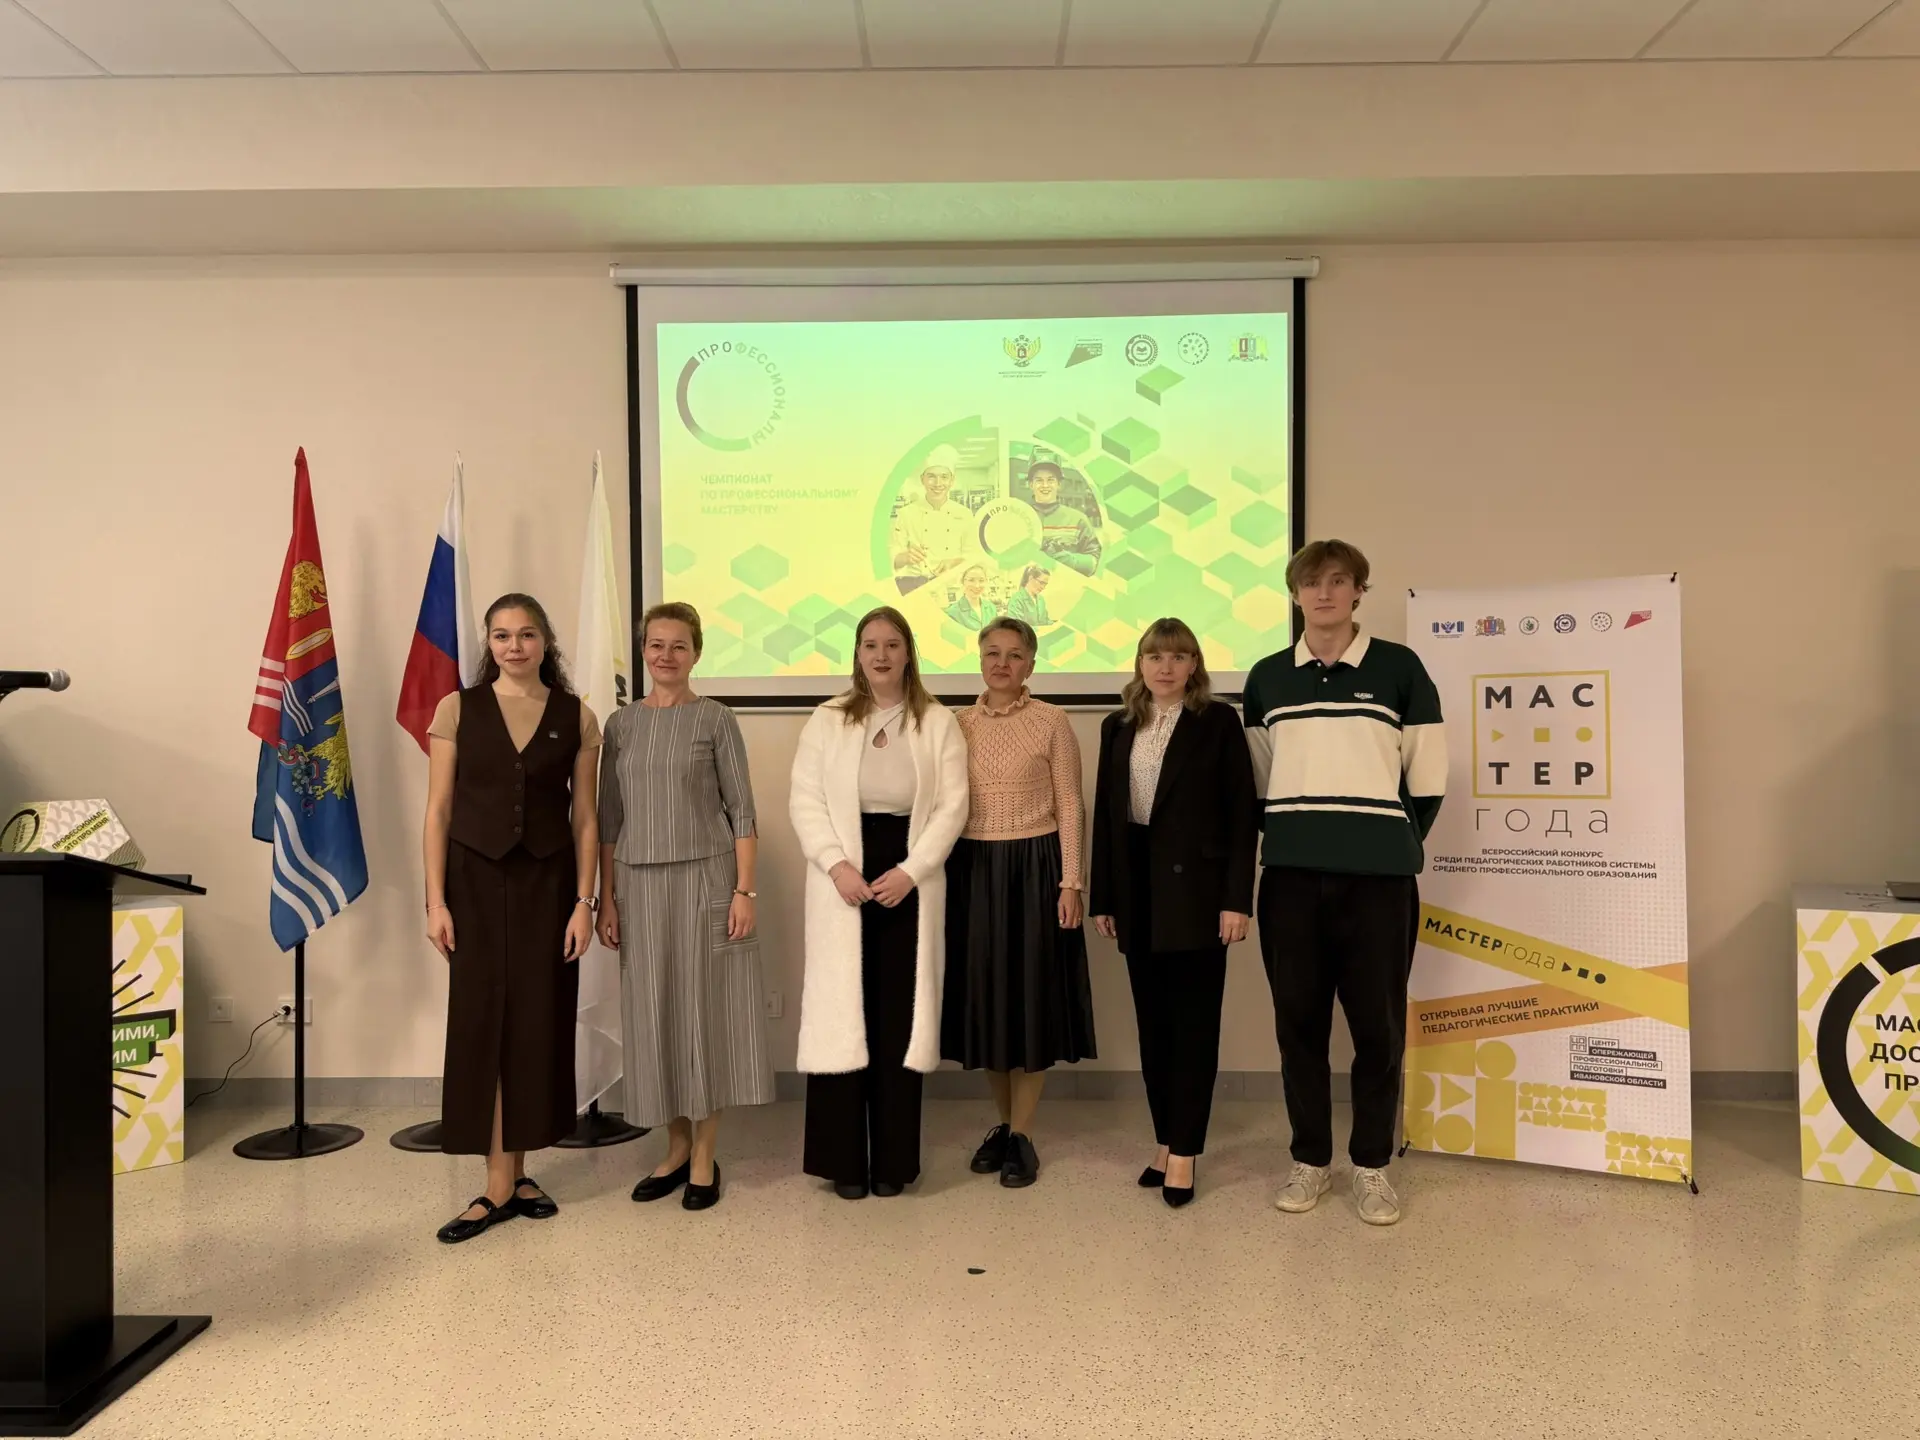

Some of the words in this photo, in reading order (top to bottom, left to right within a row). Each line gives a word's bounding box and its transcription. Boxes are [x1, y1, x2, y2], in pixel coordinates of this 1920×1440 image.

[700, 474, 772, 485] ЧЕМПИОНАТ
[64, 839, 79, 851] ЭТО
[79, 829, 93, 842] ПРО
[1482, 848, 1559, 857] ВСЕРОССИЙСКИЙ
[1560, 850, 1604, 858] КОНКУРС
[1465, 857, 1544, 866] ПЕДАГОГИЧЕСКИХ
[1546, 860, 1607, 868] РАБОТНИКОВ
[1609, 861, 1656, 869] СИСТЕМЫ
[1432, 865, 1477, 873] СРЕДНЕГО
[1479, 867, 1584, 877] ПРОФЕССИОНАЛЬНОГО
[1586, 870, 1657, 879] ОБРАЗОВАНИЯ
[1420, 1006, 1484, 1022] ОТКРЫВАЯ
[1488, 997, 1539, 1012] ЛУЧШИЕ
[1422, 1011, 1531, 1034] ПЕДАГОГИЧЕСКИЕ
[1534, 1001, 1600, 1020] ПРАКТИКИ
[1875, 1013, 1920, 1033] МА
[1592, 1048, 1654, 1059] ОПЕРЕЖАЮЩЕЙ
[1573, 1055, 1659, 1069] ПРОФЕССИОНАЛЬНОЙ
[1573, 1064, 1624, 1074] ПОДГОТОВКИ
[1573, 1072, 1626, 1084] ИВАНОВСКОЙ
[1627, 1078, 1664, 1087] ОБЛАСТИ
